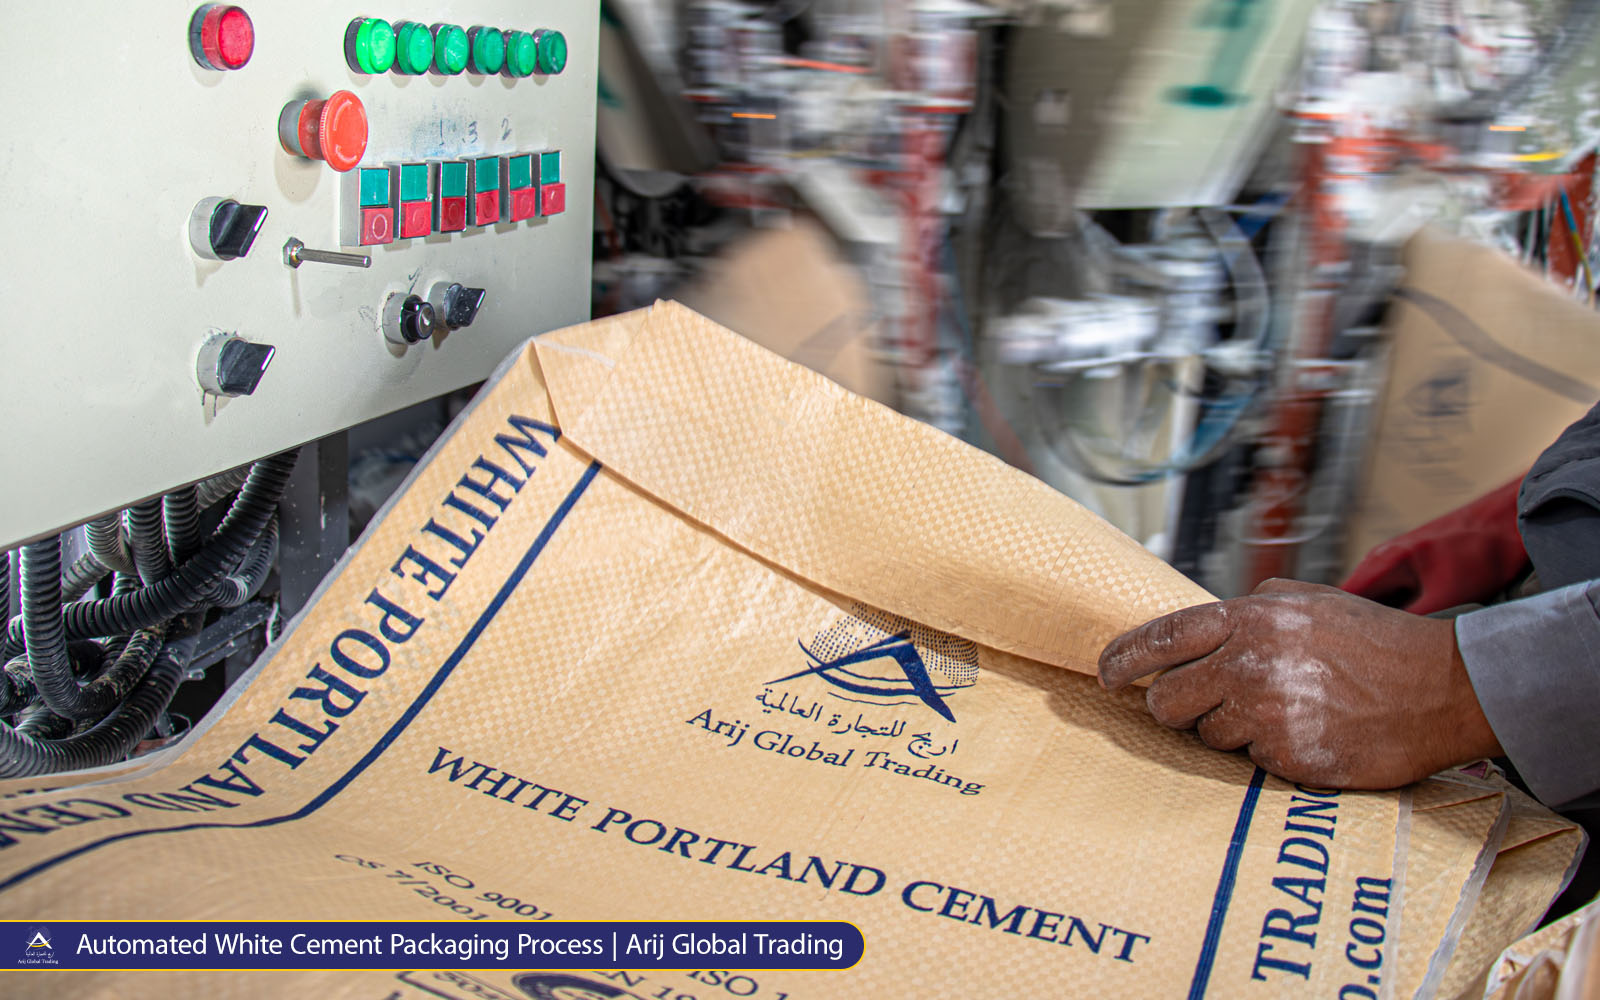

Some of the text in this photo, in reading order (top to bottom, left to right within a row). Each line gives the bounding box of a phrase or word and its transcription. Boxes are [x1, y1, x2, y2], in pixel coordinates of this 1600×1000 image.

[390, 413, 563, 602] WHITE
[121, 587, 426, 813] PORTLAND
[686, 707, 986, 797] Arij Global Trading
[755, 687, 824, 722] العالمية
[411, 861, 554, 920] ISO 9001
[426, 746, 1151, 963] WHITE PORTLAND CEMENT
[1251, 784, 1342, 982] TRADIN
